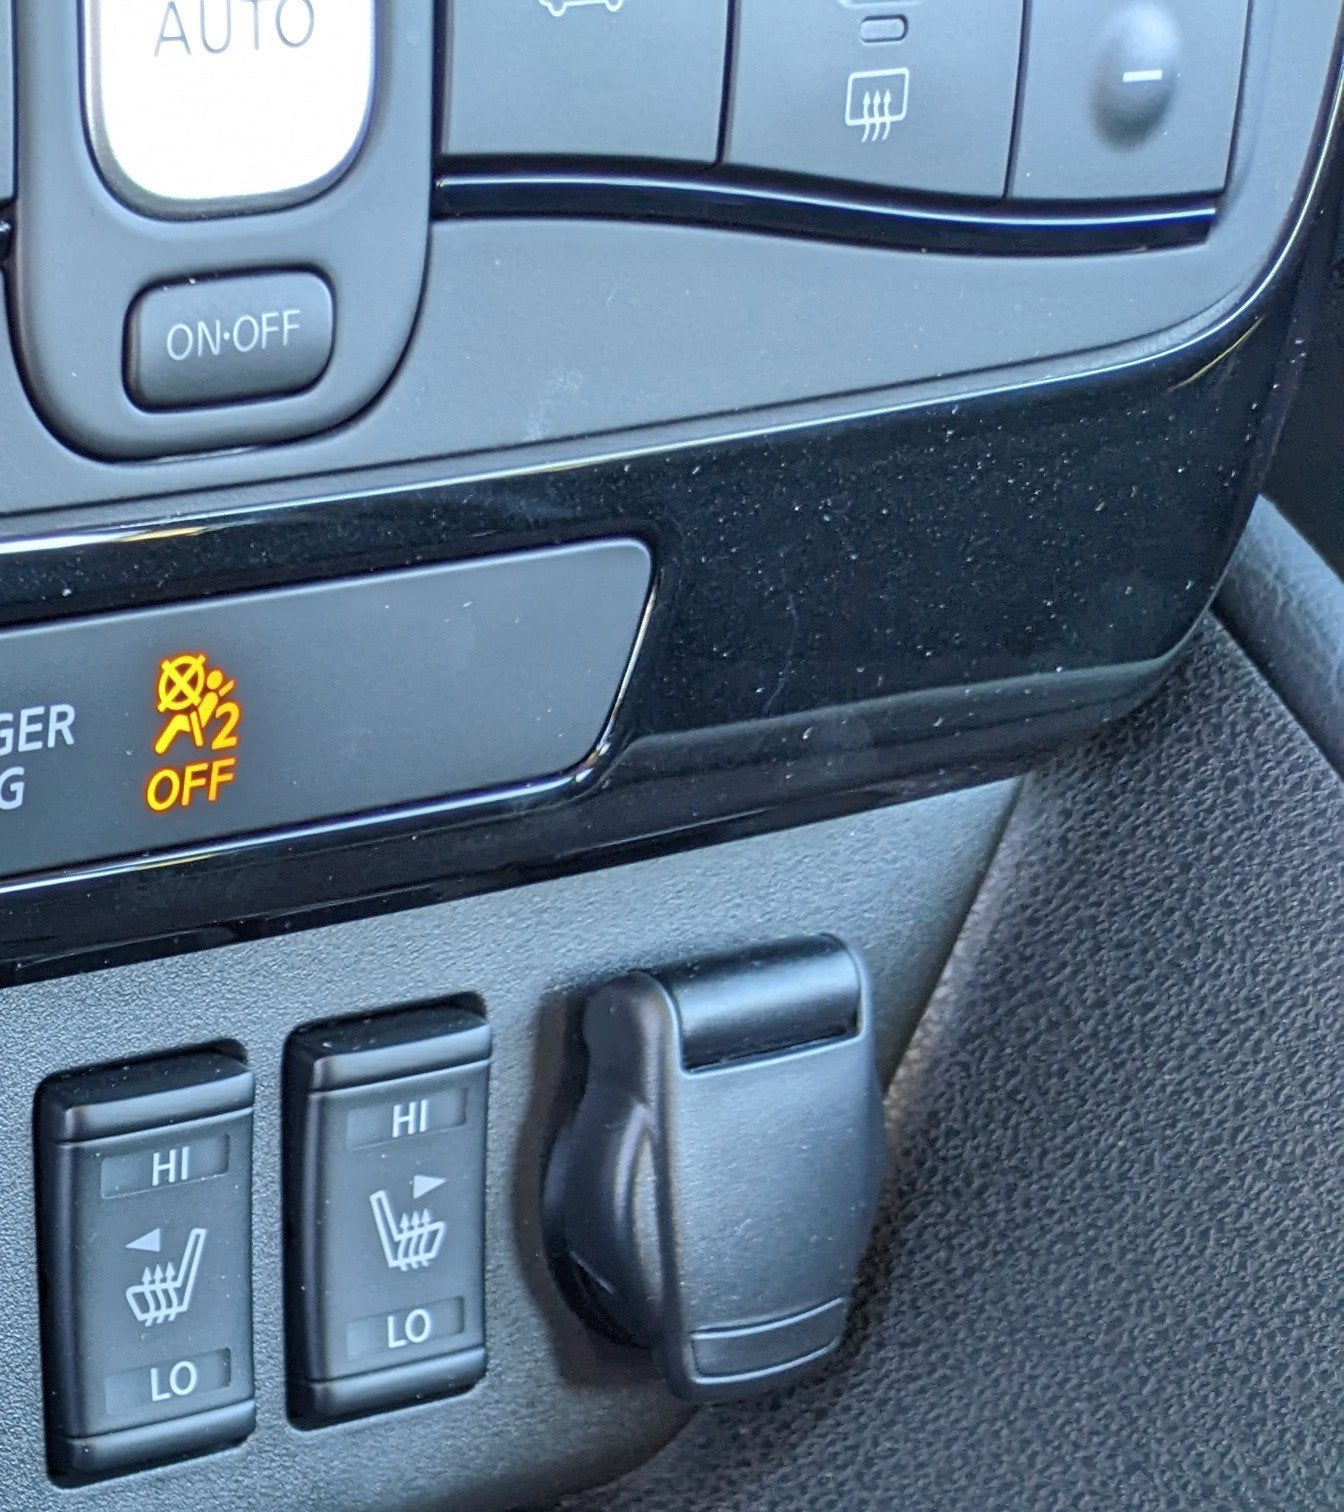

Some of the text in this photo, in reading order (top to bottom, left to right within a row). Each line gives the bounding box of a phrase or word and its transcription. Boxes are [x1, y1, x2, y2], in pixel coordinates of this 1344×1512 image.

[154, 0, 314, 57] AUTO
[146, 758, 237, 812] OFF
[391, 1100, 430, 1138] HI
[152, 1147, 190, 1187] HI
[387, 1309, 433, 1348] LO
[150, 1360, 198, 1402] LO
